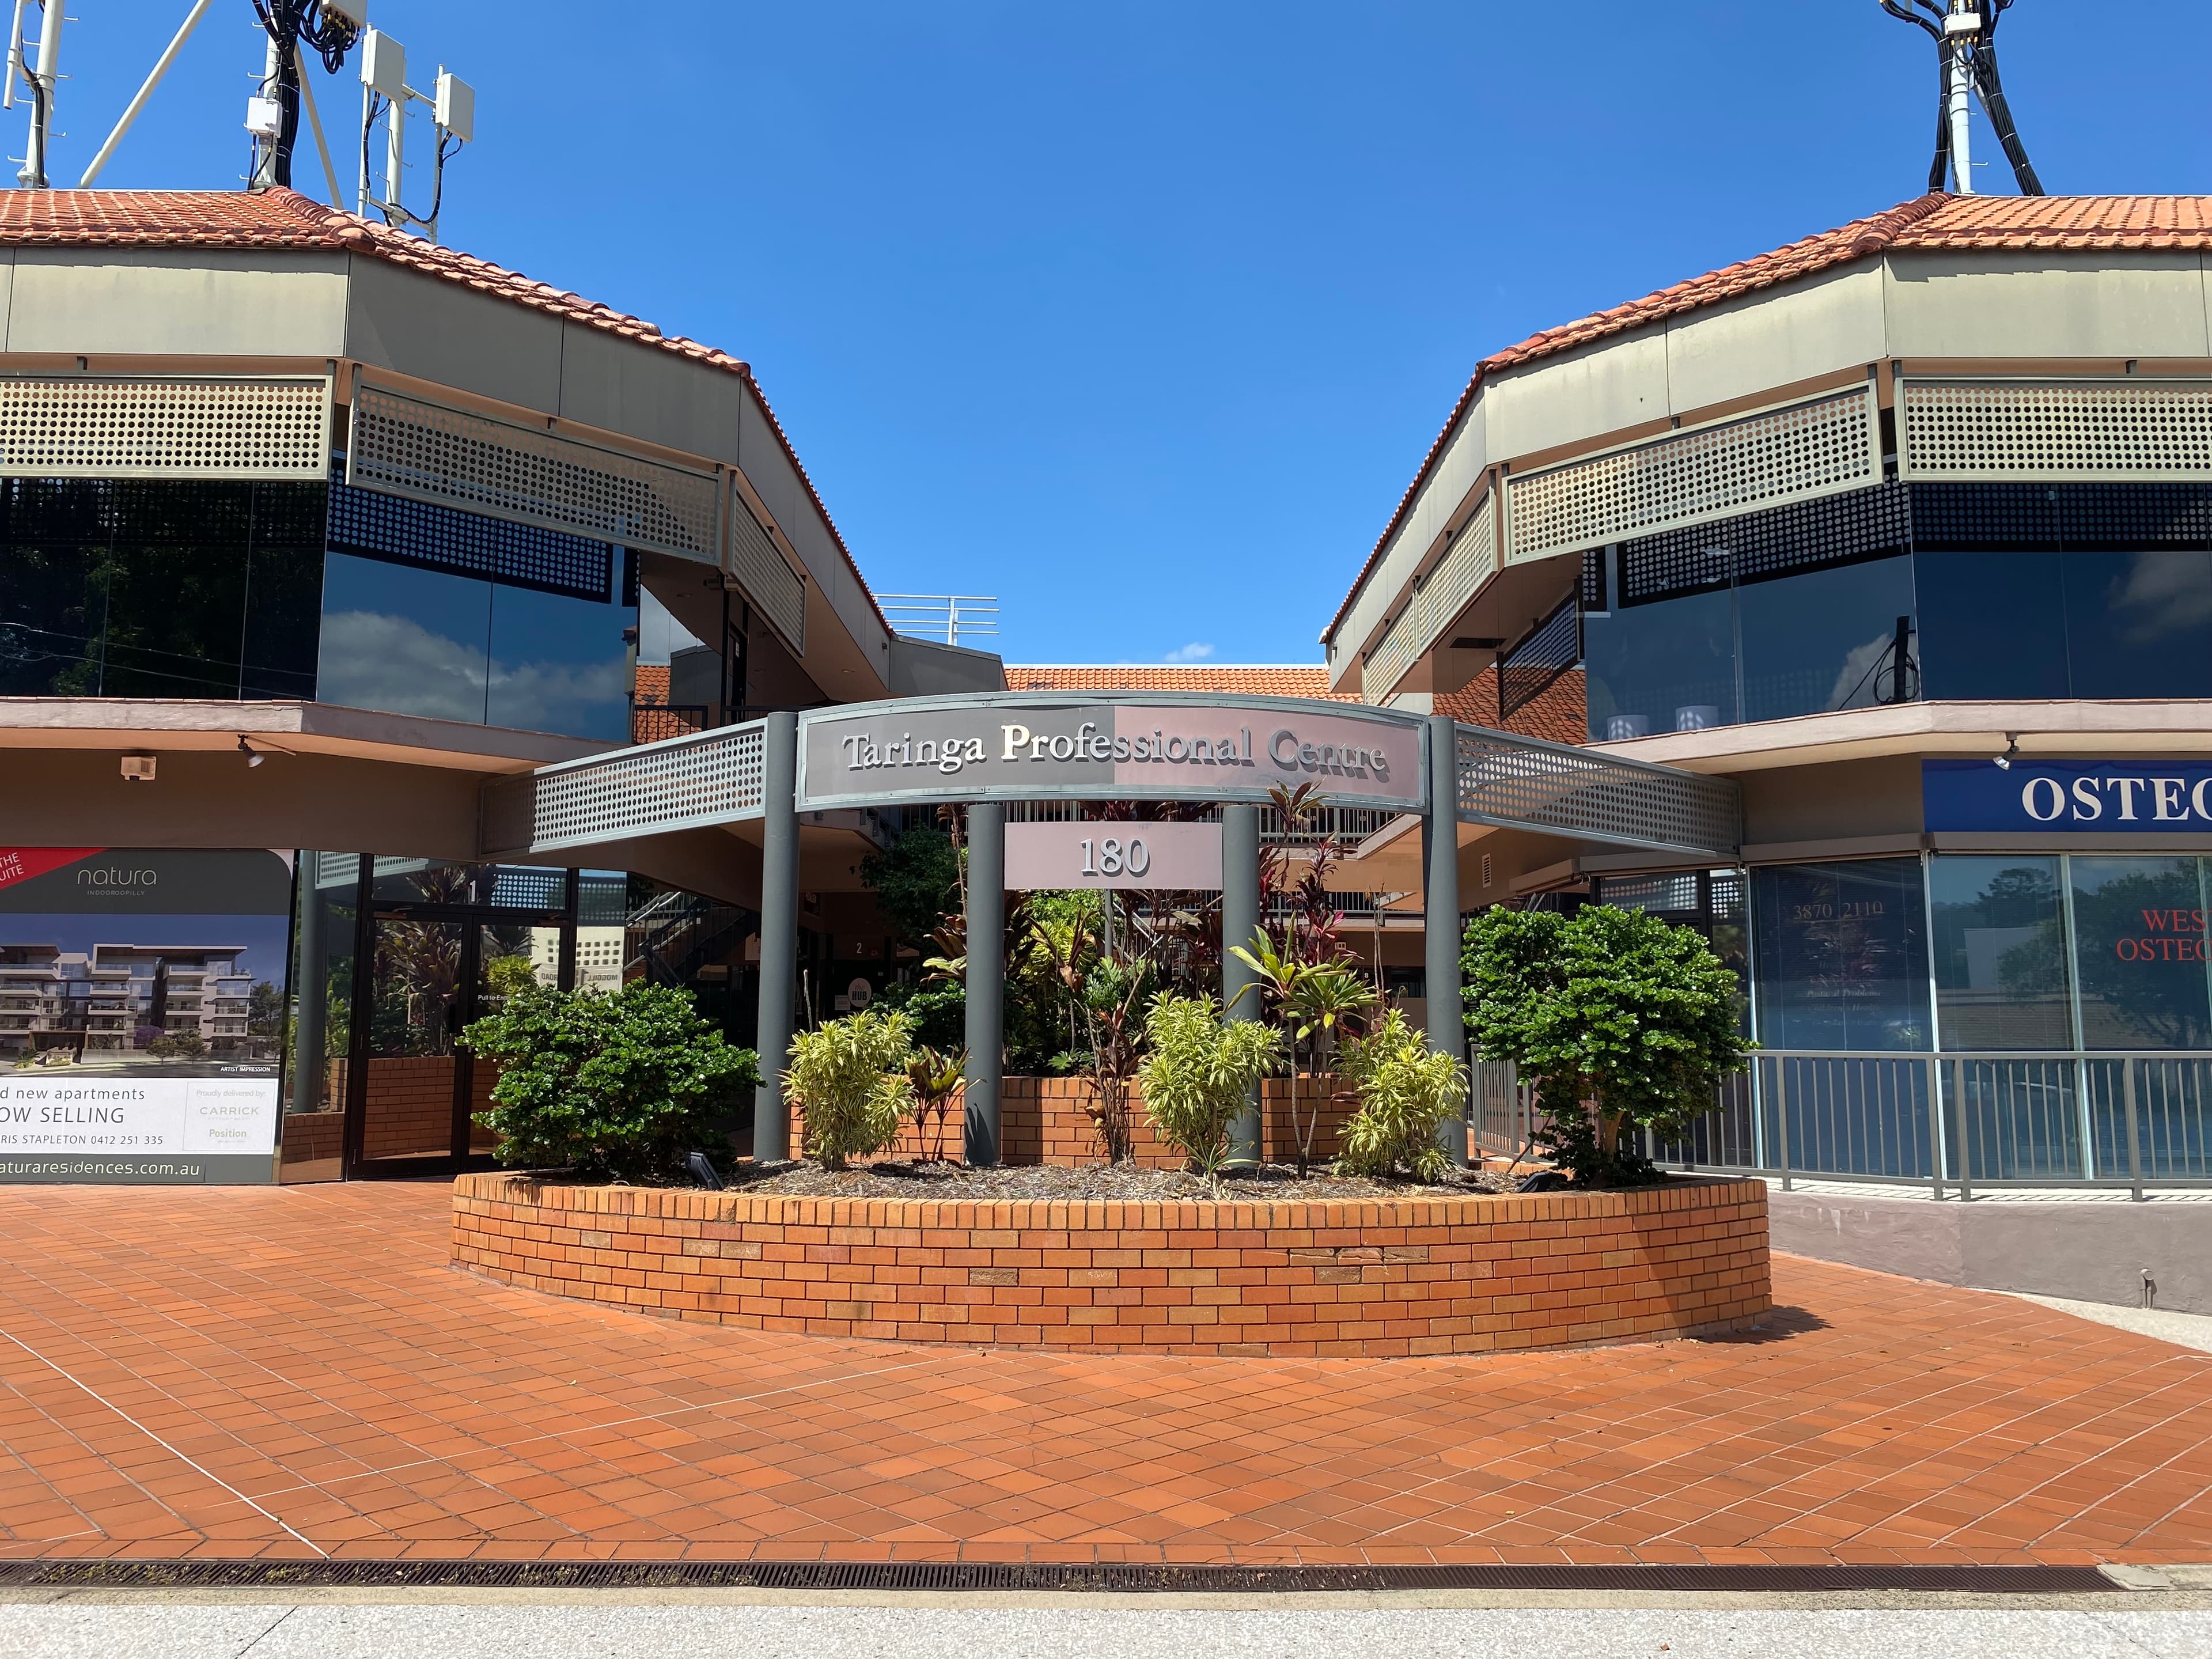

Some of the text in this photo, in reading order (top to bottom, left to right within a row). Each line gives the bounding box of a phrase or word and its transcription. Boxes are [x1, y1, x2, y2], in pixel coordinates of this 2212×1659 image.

[842, 722, 1386, 773] Taringa Professional Centre
[1080, 838, 1149, 873] 180
[77, 866, 157, 885] natura
[469, 880, 476, 902] 1
[1793, 900, 1884, 920] 3870 2110
[857, 942, 862, 954] 2
[852, 991, 867, 1001] HUB
[16, 1090, 48, 1099] new
[55, 1088, 145, 1102] apartments
[196, 1089, 222, 1099] Proudly
[40, 1107, 124, 1123] SELLING
[200, 1107, 259, 1115] CARRICK
[1, 1134, 164, 1145] RIS STAPLETON 0412 251 335
[209, 1128, 247, 1138] Position
[0, 1160, 200, 1176] aturaresidences.com.au
